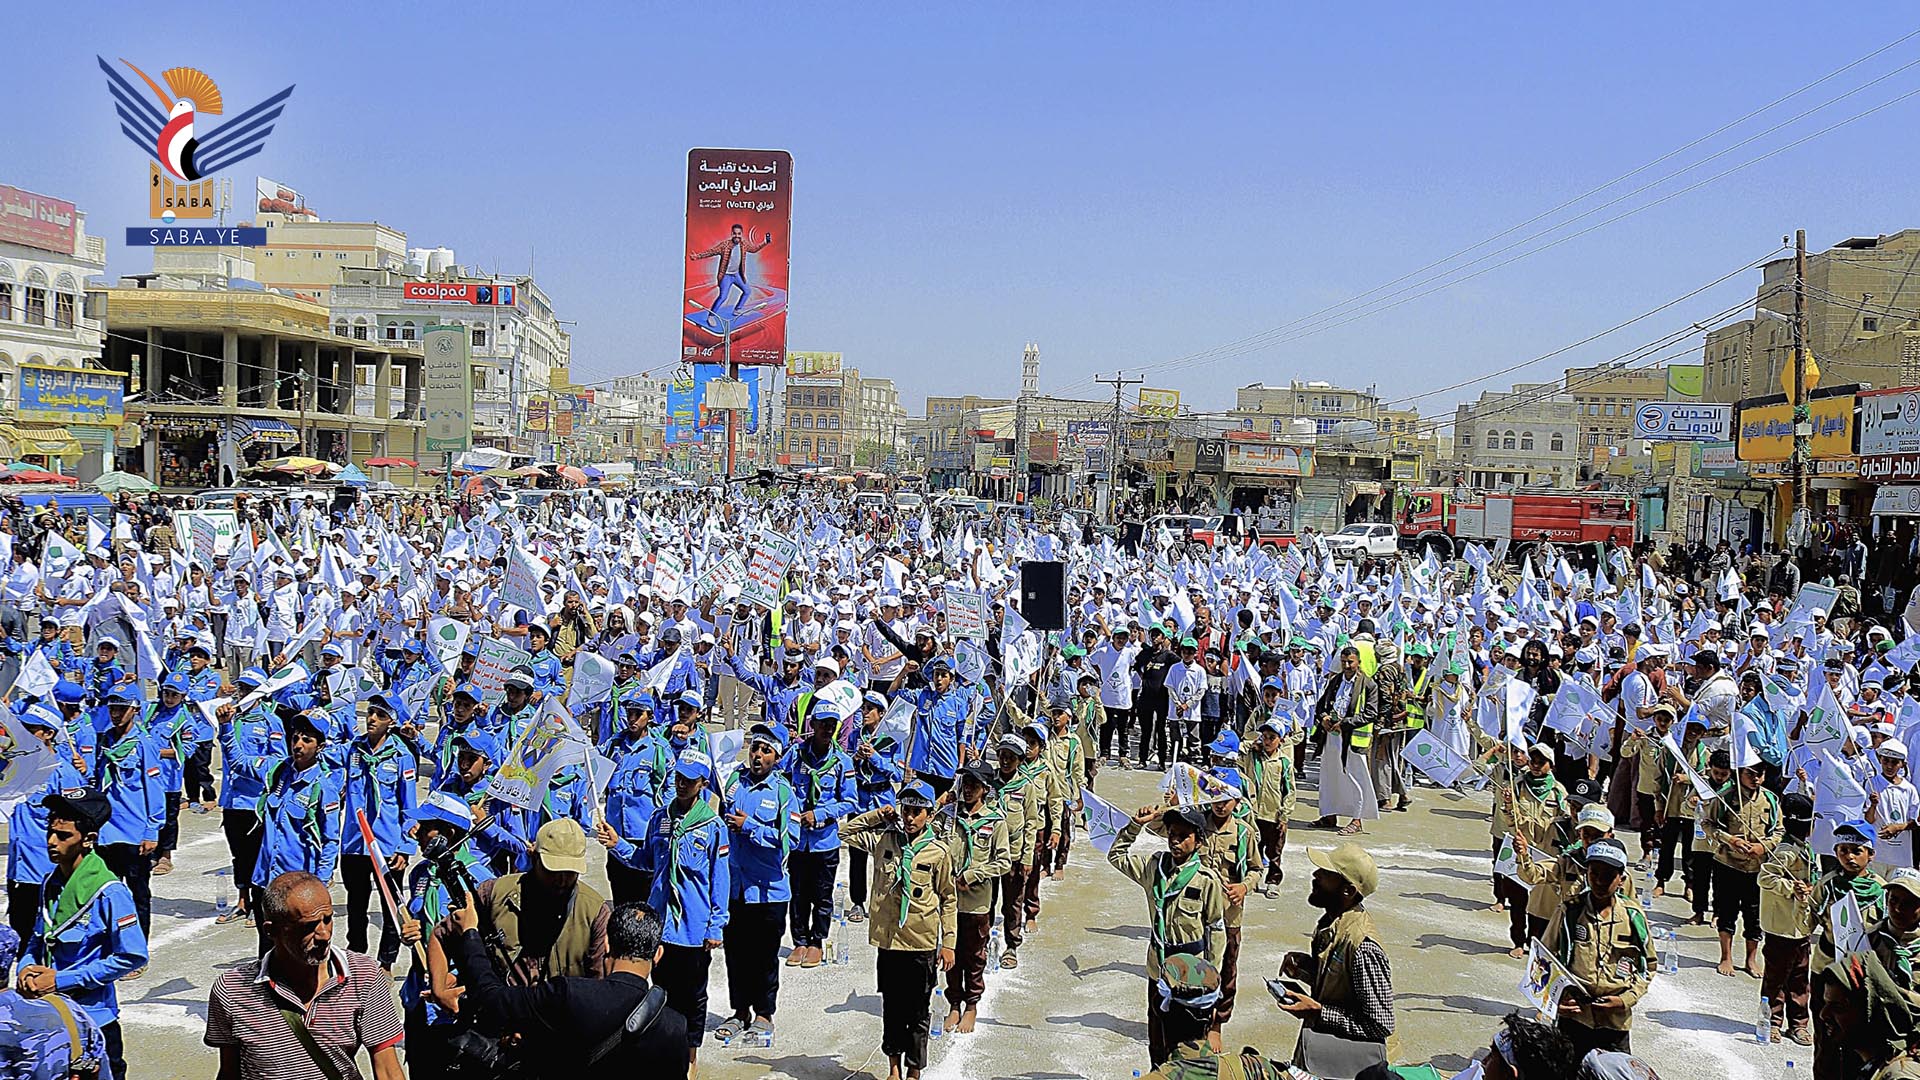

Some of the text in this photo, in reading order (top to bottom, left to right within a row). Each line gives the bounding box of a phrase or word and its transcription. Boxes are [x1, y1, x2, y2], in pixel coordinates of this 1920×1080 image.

[699, 160, 776, 174] أحدث تقنية
[698, 178, 776, 196] اتصال في اليمن
[726, 200, 755, 210] (VoLTE)
[411, 284, 467, 299] coolpad
[701, 348, 714, 356] 4G
[1671, 405, 1721, 421] الحديث
[1197, 443, 1223, 456] ASA
[1861, 456, 1892, 480] للتجارة
[507, 656, 525, 665] الله
